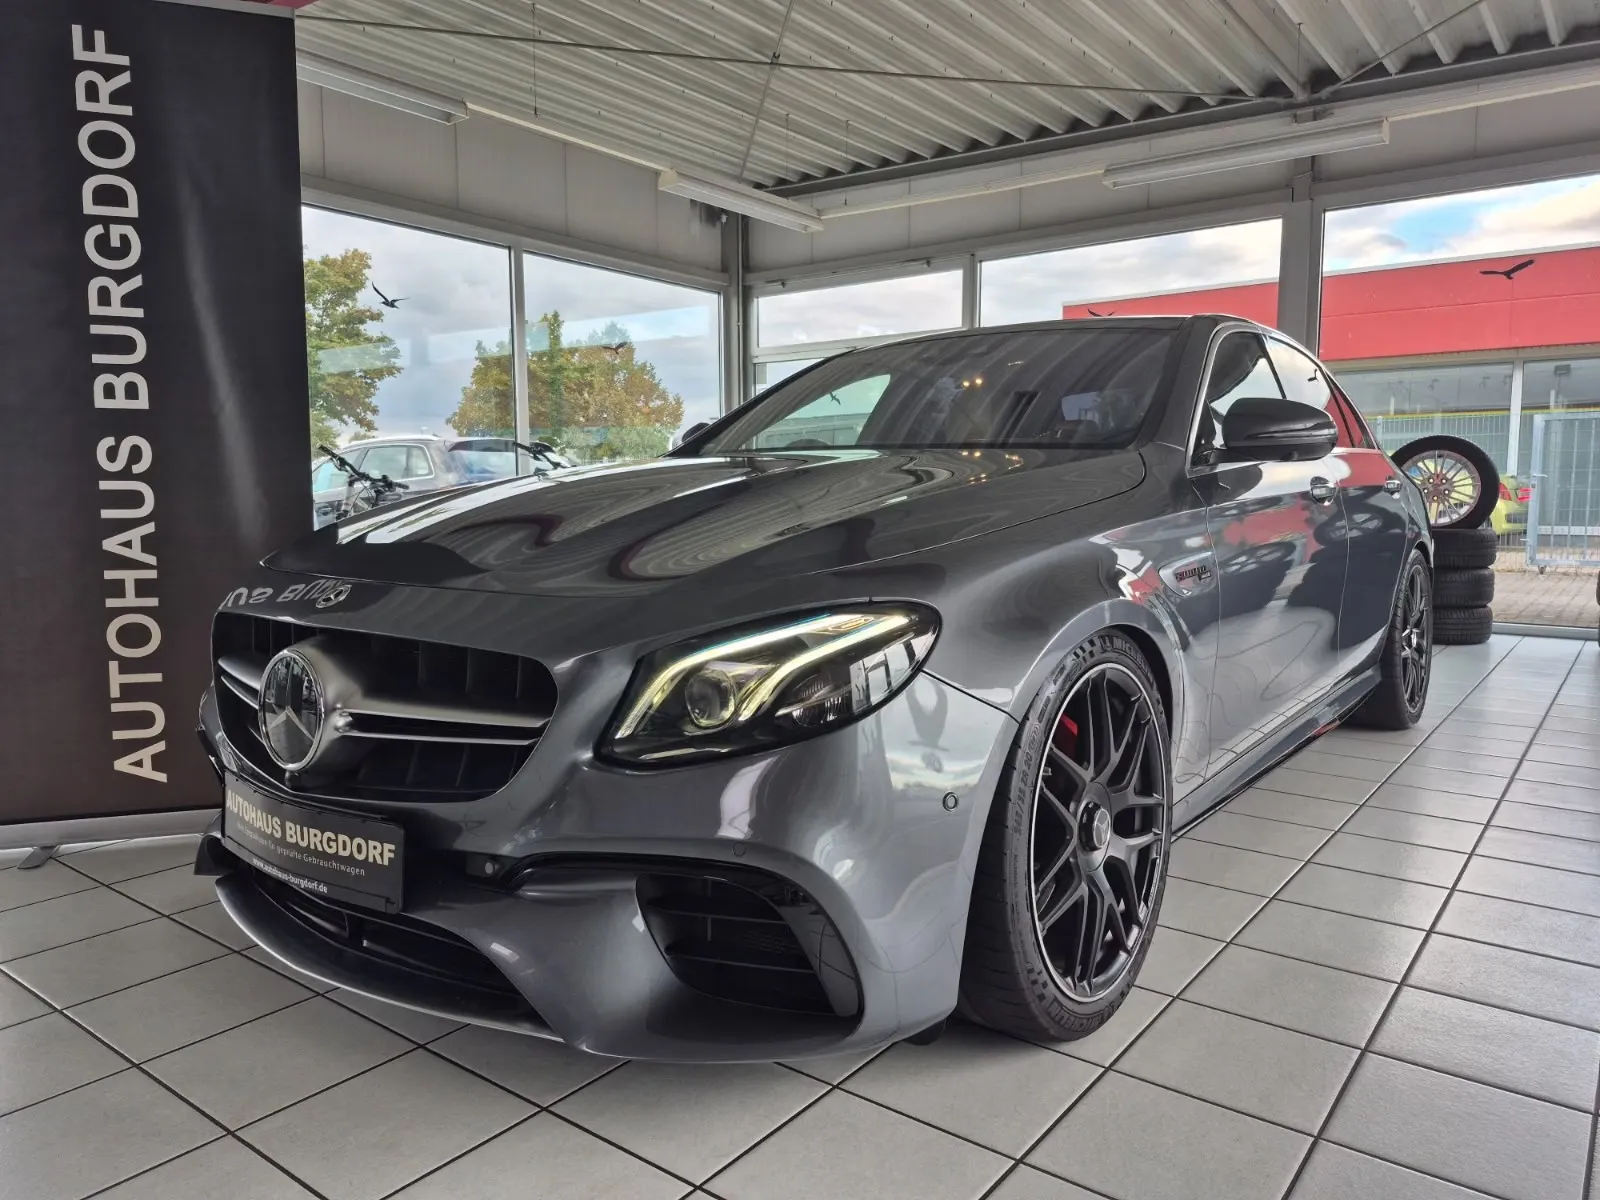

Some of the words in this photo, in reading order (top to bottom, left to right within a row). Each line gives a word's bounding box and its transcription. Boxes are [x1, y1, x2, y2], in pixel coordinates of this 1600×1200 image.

[71, 24, 149, 412] BURGDORF
[97, 434, 167, 784] AUTOHAUS
[226, 789, 282, 839] AUTOHAUS
[285, 820, 396, 866] BURGDORF
[303, 853, 365, 876] Gebrauchtwagen
[252, 857, 328, 894] www.autohaus-burgdorf.de
